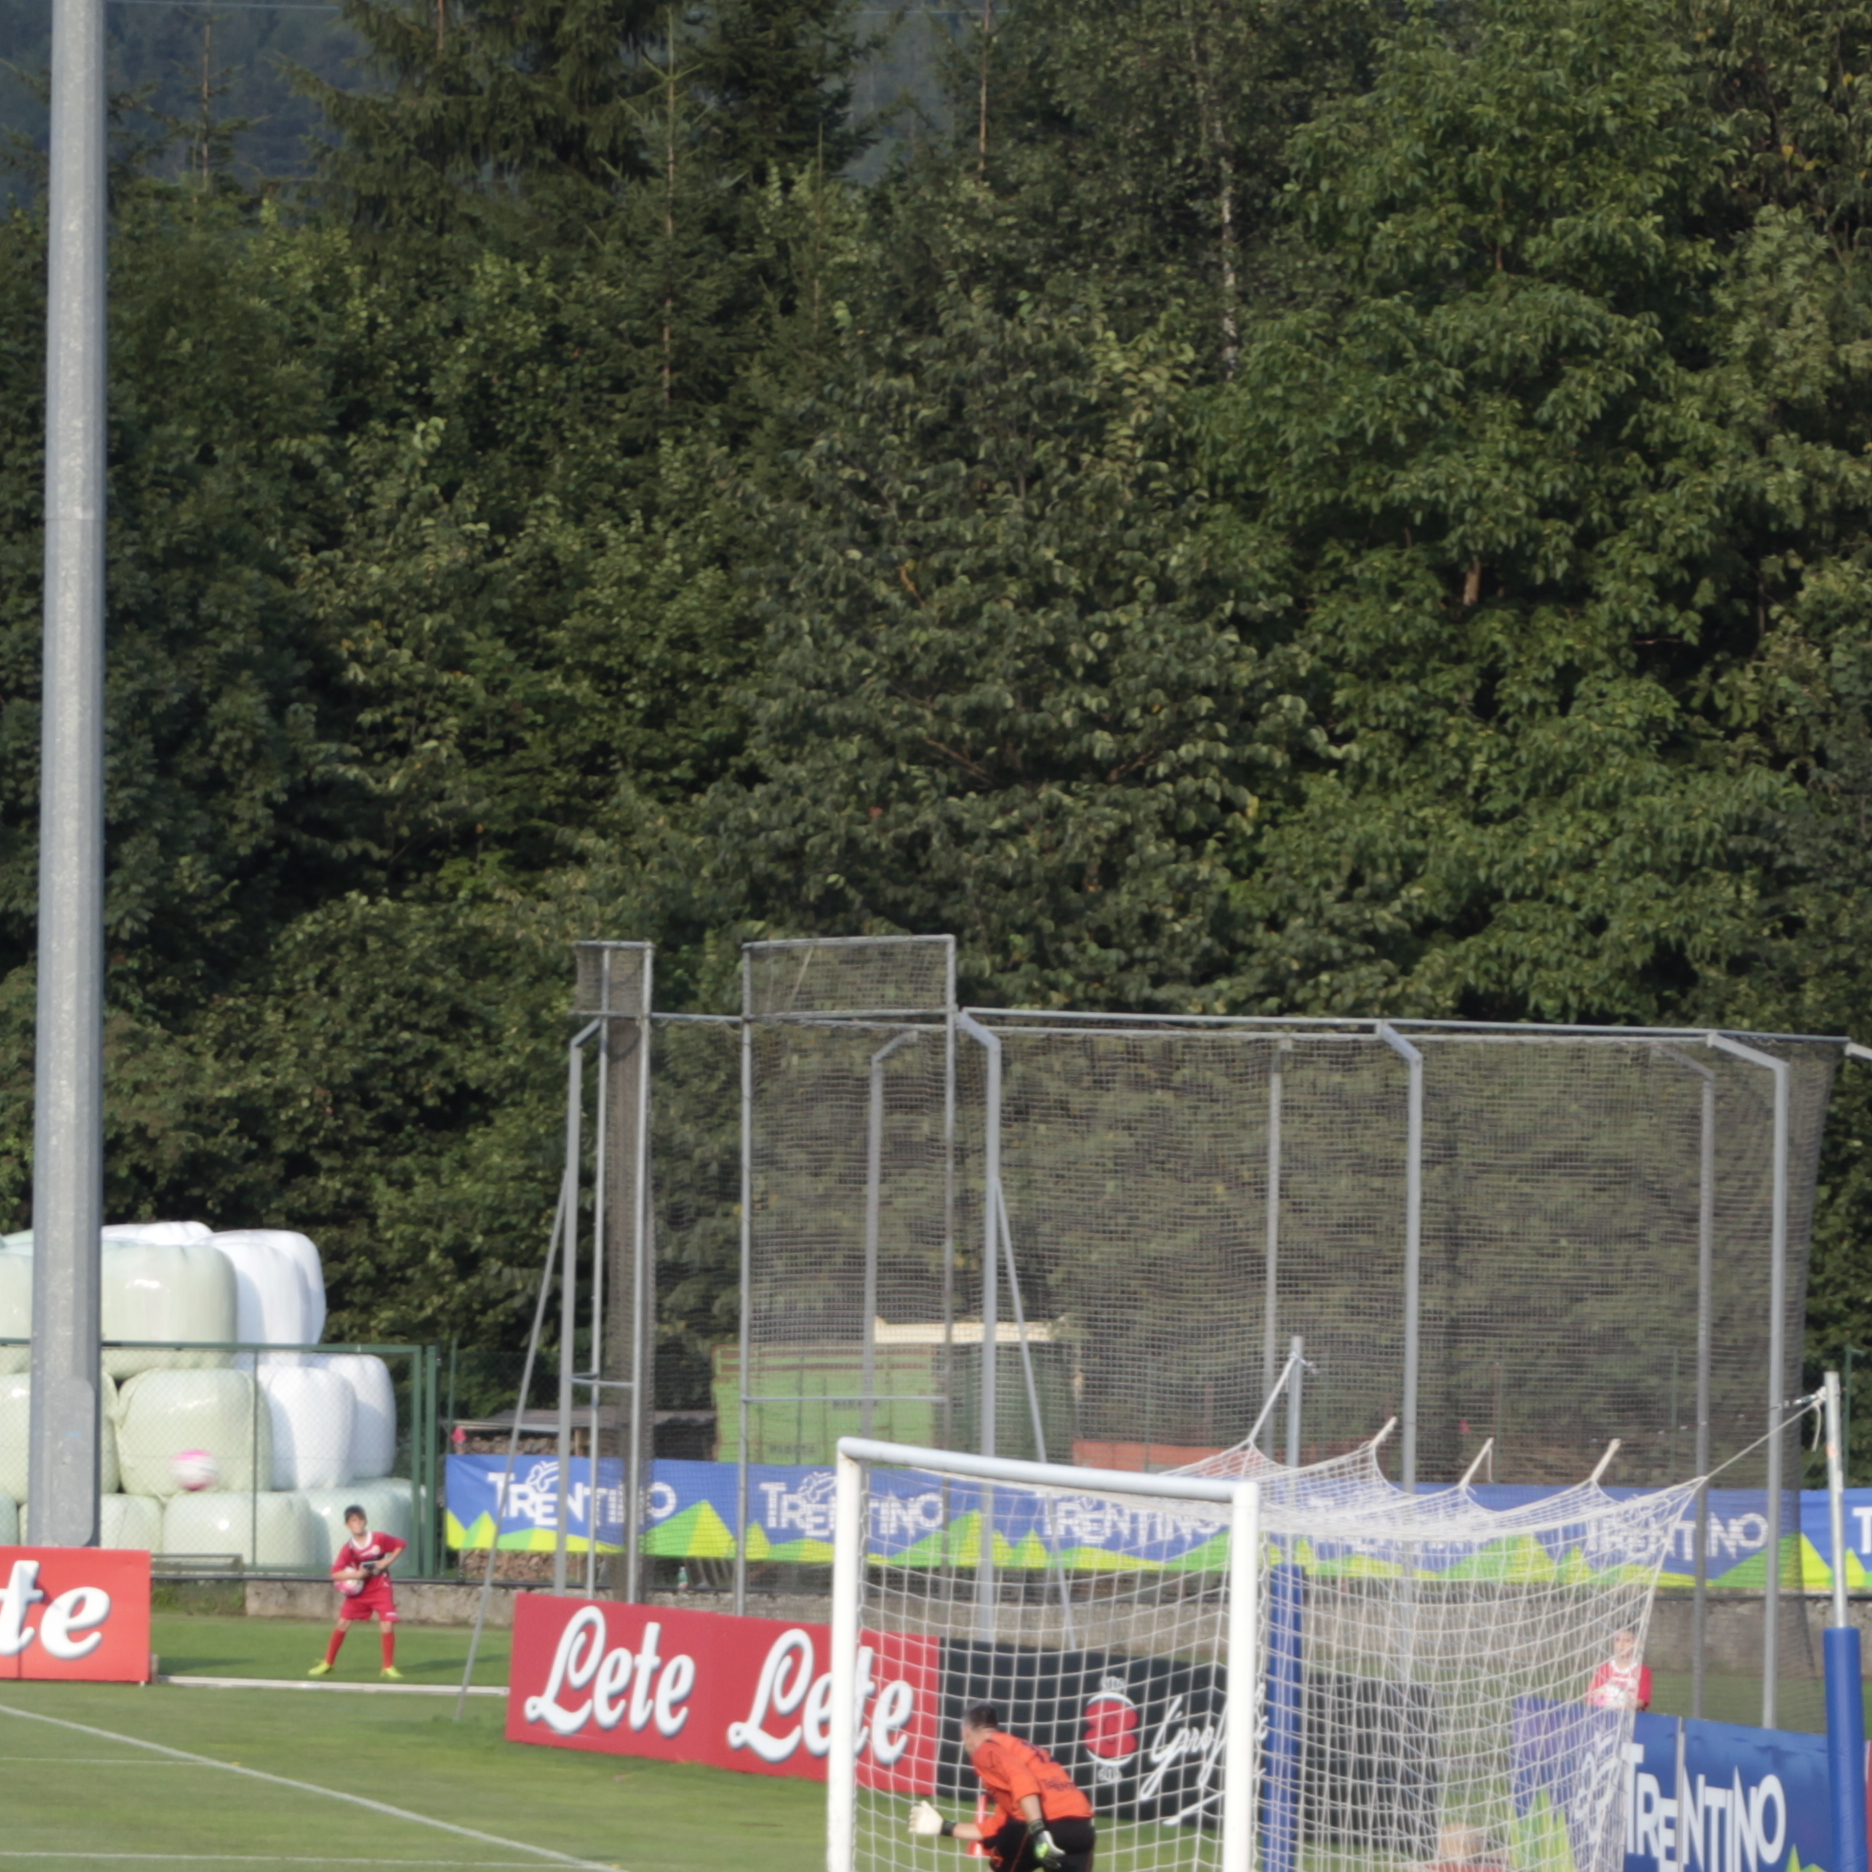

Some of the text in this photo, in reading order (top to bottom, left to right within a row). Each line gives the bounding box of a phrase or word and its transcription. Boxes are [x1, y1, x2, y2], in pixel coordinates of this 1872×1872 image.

[759, 1482, 944, 1537] TREINO
[1588, 1512, 1769, 1561] TRENTNO
[525, 1605, 696, 1737] Lete
[728, 1629, 914, 1765] Lete
